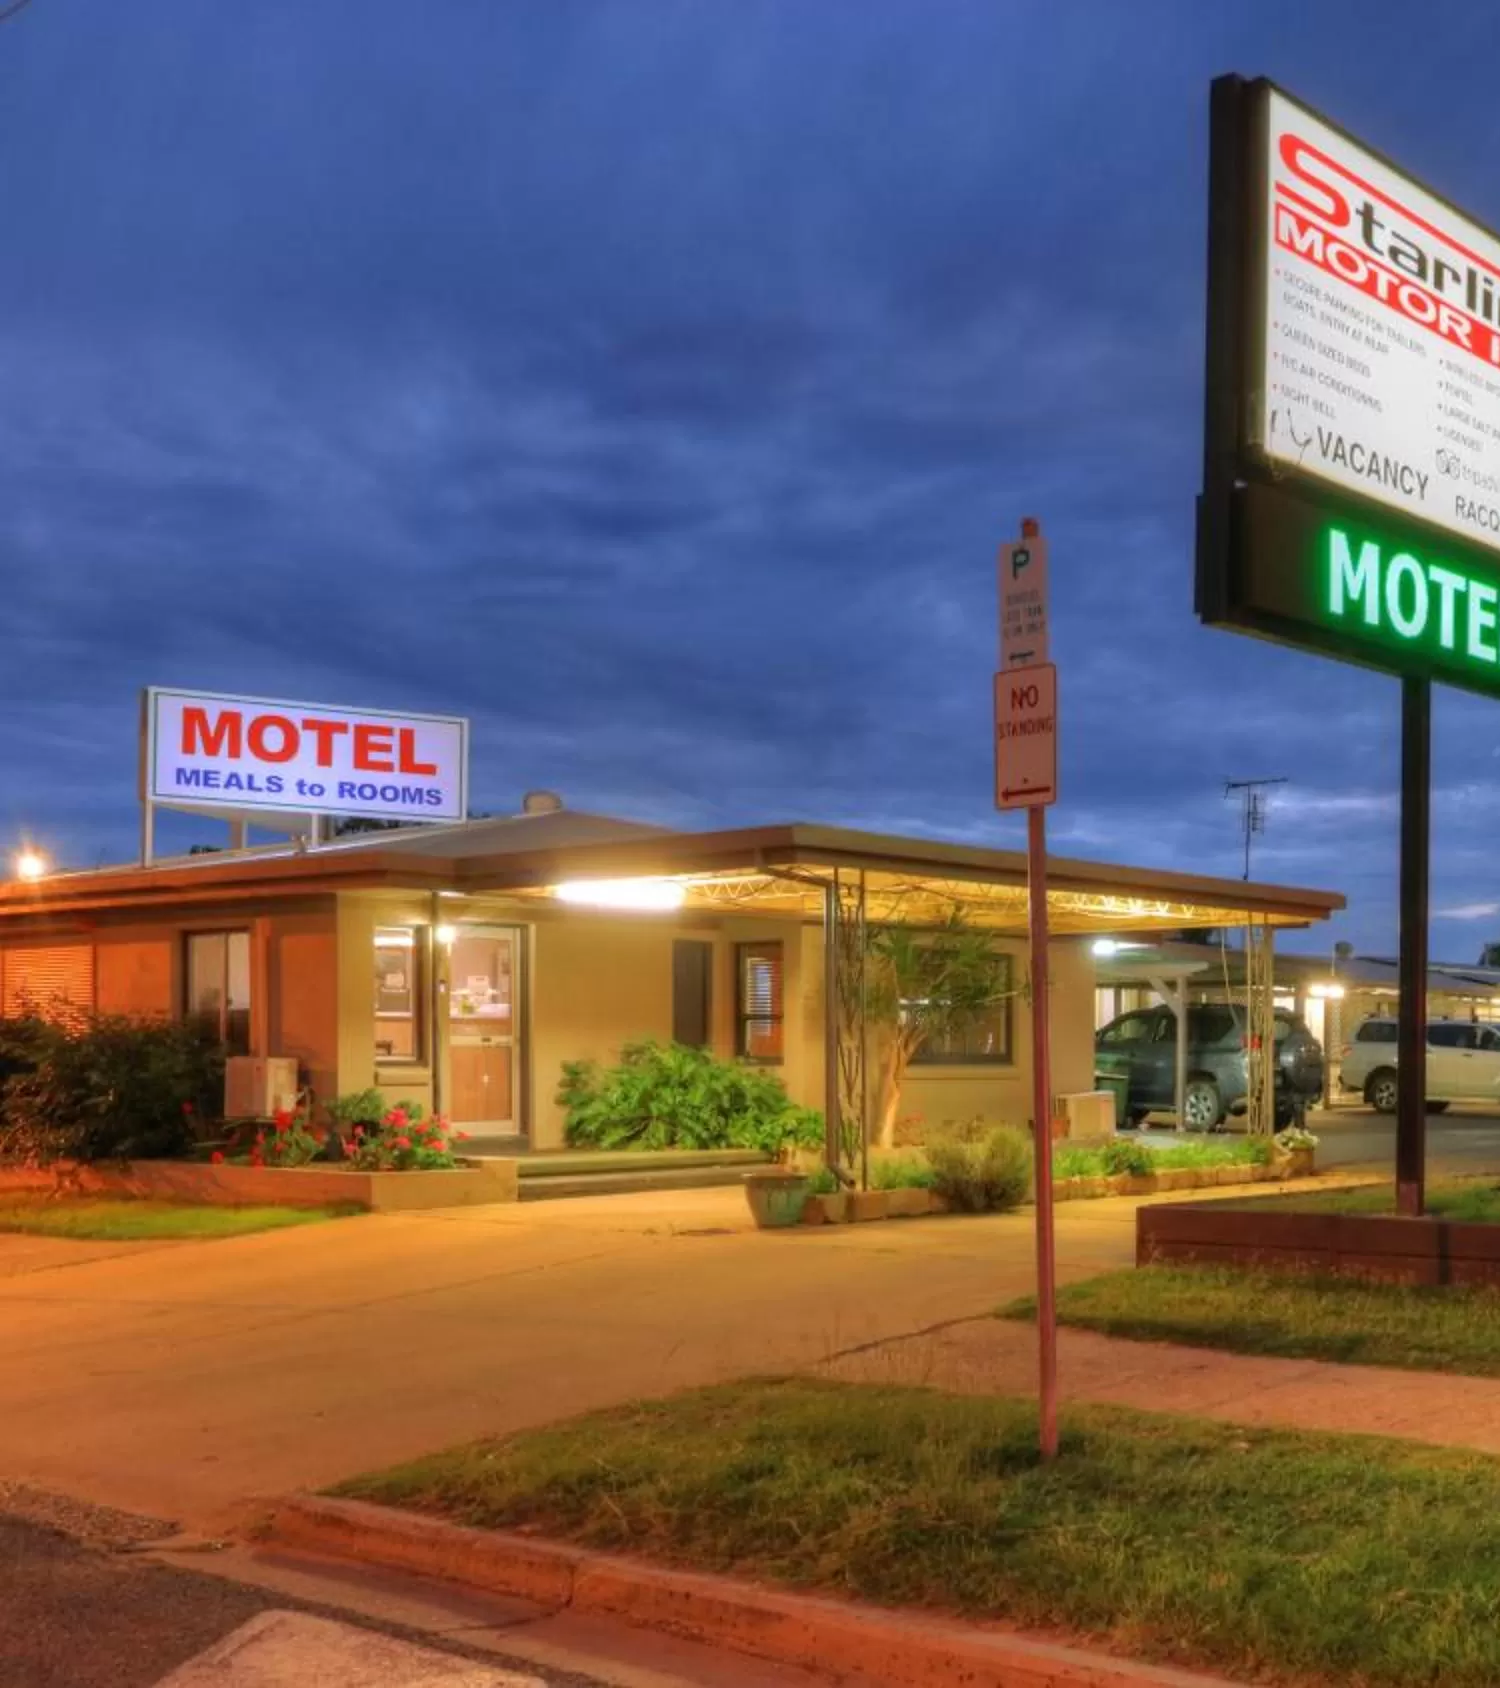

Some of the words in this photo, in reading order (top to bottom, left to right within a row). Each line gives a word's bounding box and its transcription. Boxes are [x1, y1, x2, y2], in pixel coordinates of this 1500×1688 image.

[1278, 213, 1473, 352] MOTOR
[1317, 425, 1428, 500] VACANCY
[1455, 495, 1500, 532] RACQ
[1011, 547, 1030, 580] P
[1011, 685, 1039, 710] NO
[181, 705, 438, 777] MOTEL
[998, 715, 1053, 741] STANDING
[175, 767, 284, 794] MEALS
[295, 778, 325, 798] to
[337, 780, 443, 806] ROOMS
